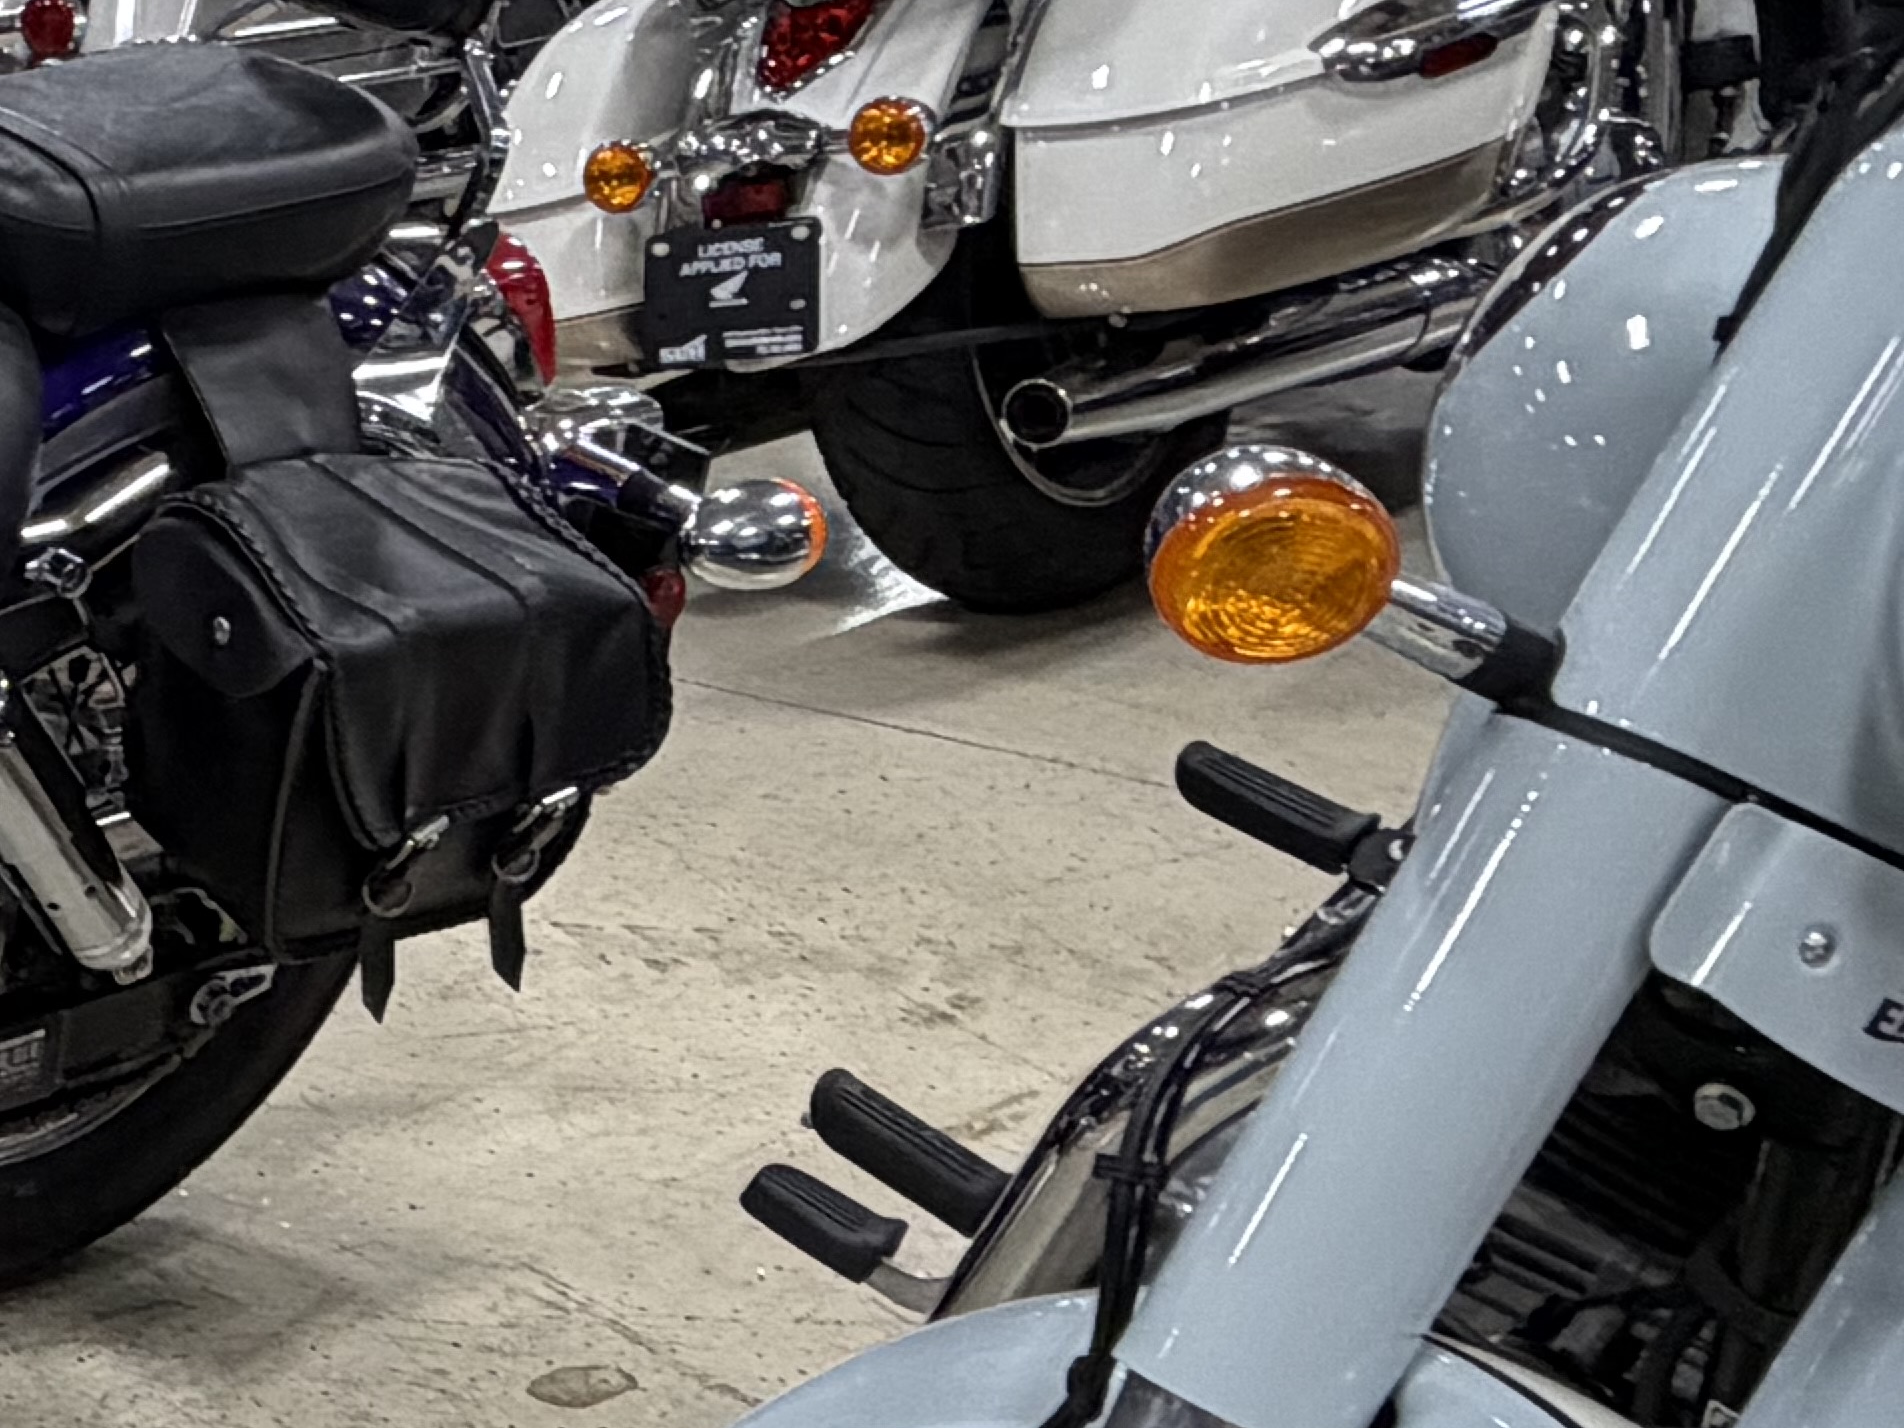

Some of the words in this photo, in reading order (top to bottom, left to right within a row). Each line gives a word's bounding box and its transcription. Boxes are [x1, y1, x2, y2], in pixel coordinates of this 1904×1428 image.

[697, 236, 765, 258] LICENSE
[678, 256, 746, 277] APPLIED
[748, 251, 782, 268] FOR
